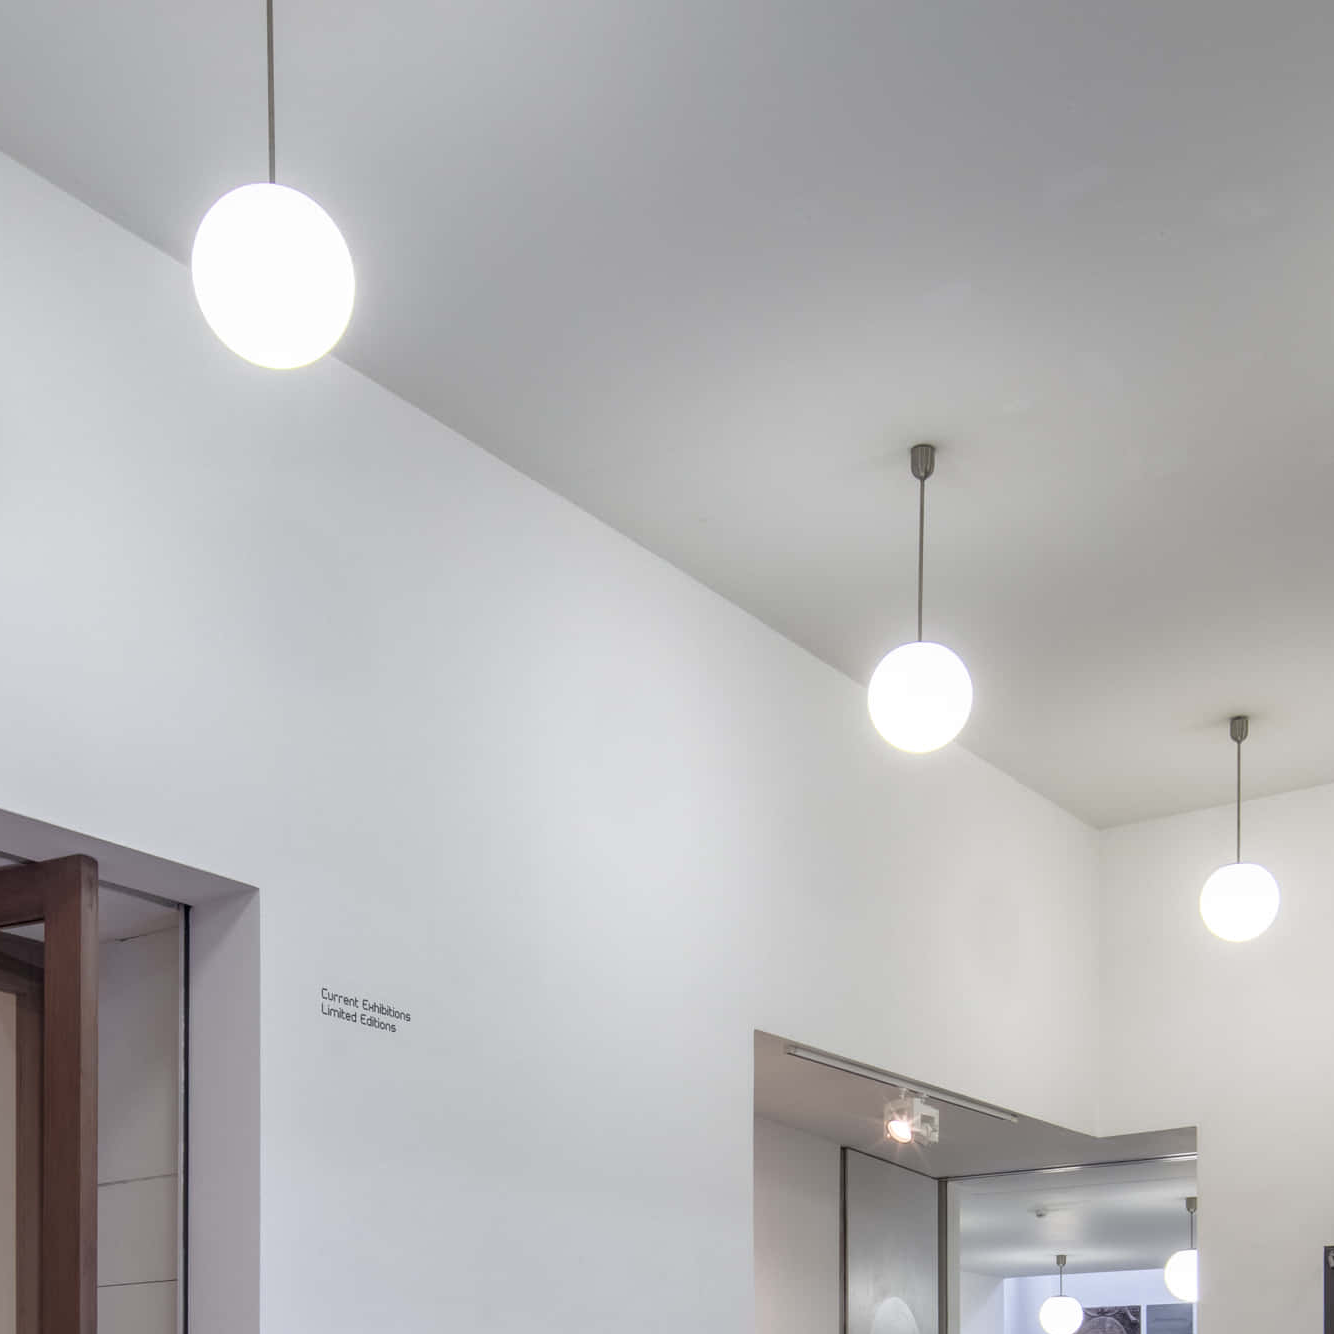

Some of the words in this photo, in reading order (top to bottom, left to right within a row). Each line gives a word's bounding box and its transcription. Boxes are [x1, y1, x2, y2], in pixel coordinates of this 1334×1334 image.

[321, 987, 359, 1008] Current
[362, 999, 411, 1021] Exhibitions
[321, 1002, 357, 1022] Limited
[360, 1013, 396, 1032] Editions
